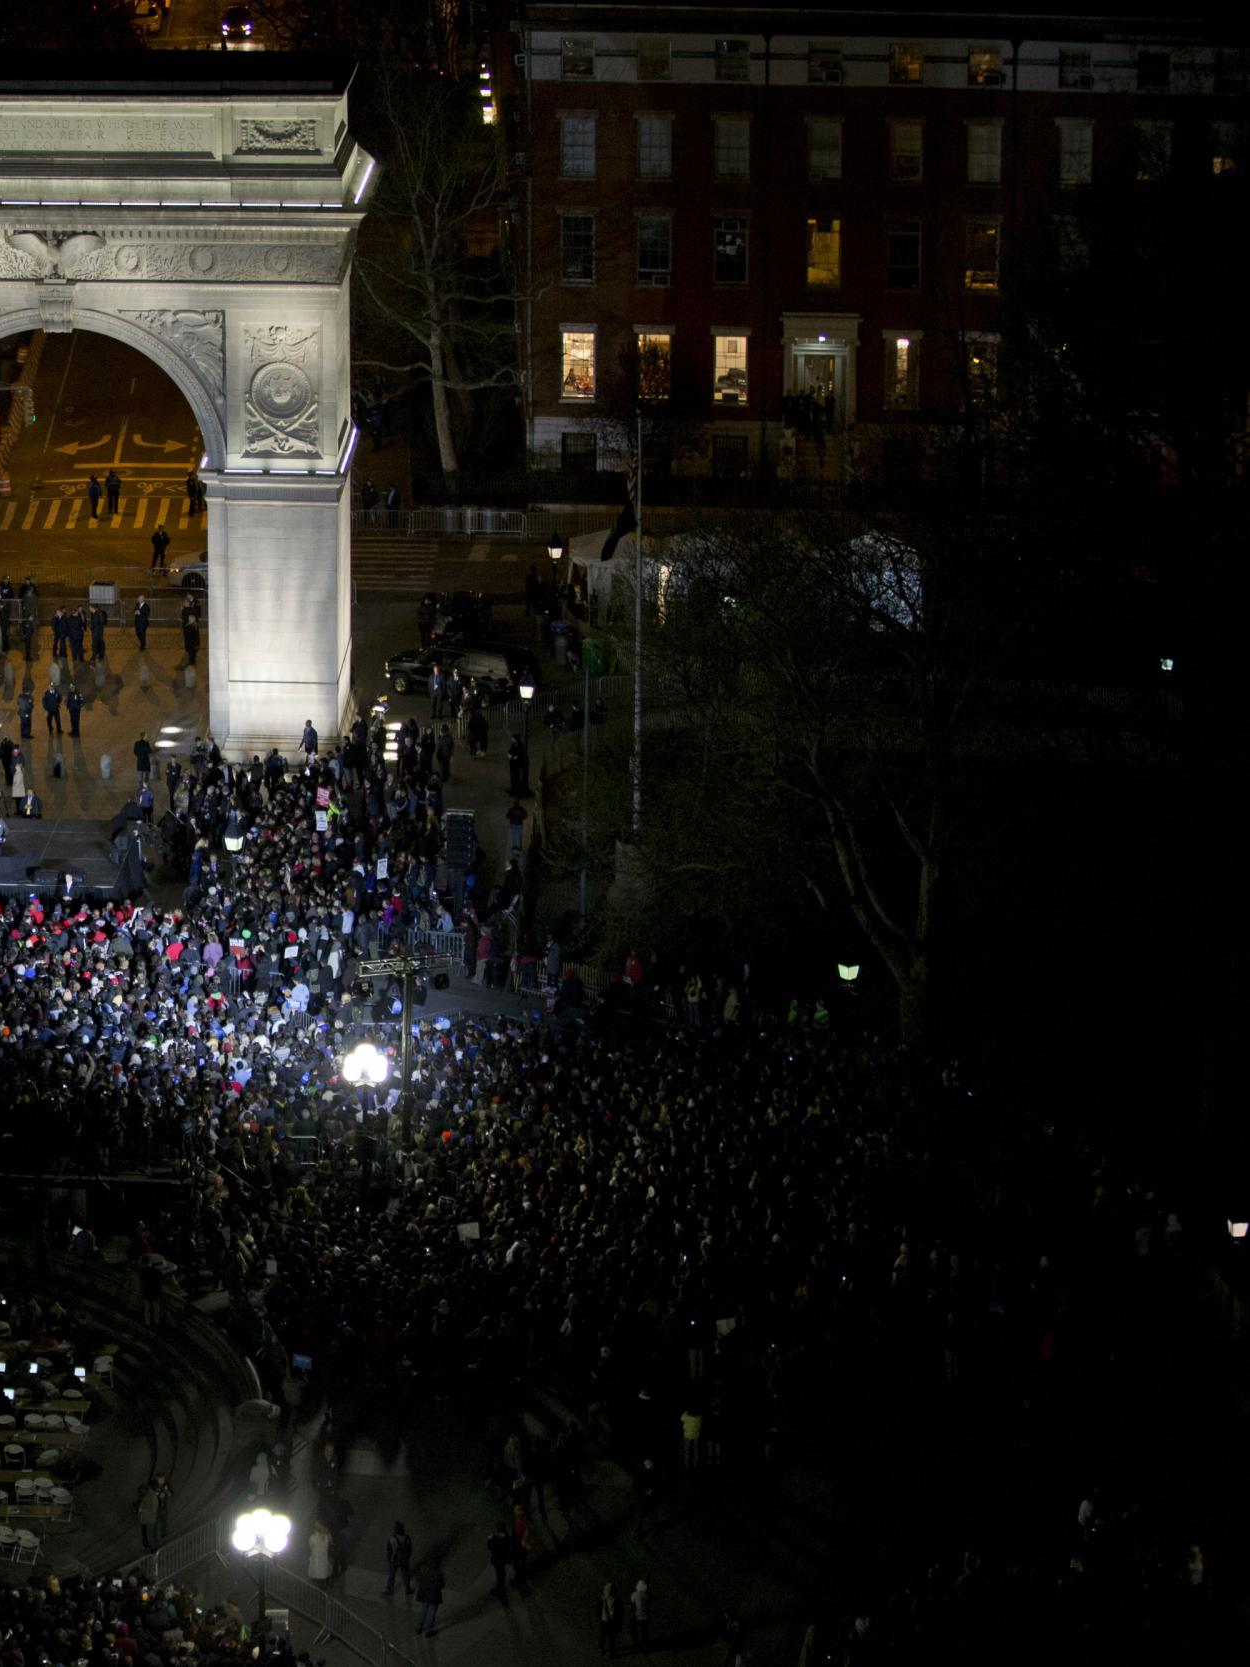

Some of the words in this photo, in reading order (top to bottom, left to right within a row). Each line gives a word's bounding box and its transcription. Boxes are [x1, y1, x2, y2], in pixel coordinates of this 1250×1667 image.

[3, 119, 70, 129] STANDARD
[75, 119, 91, 129] TO
[97, 119, 139, 129] WHICH
[143, 119, 170, 129] THE
[173, 119, 204, 129] WISE
[60, 130, 104, 140] REPAIR
[126, 130, 152, 140] THE
[159, 130, 204, 140] EVENT
